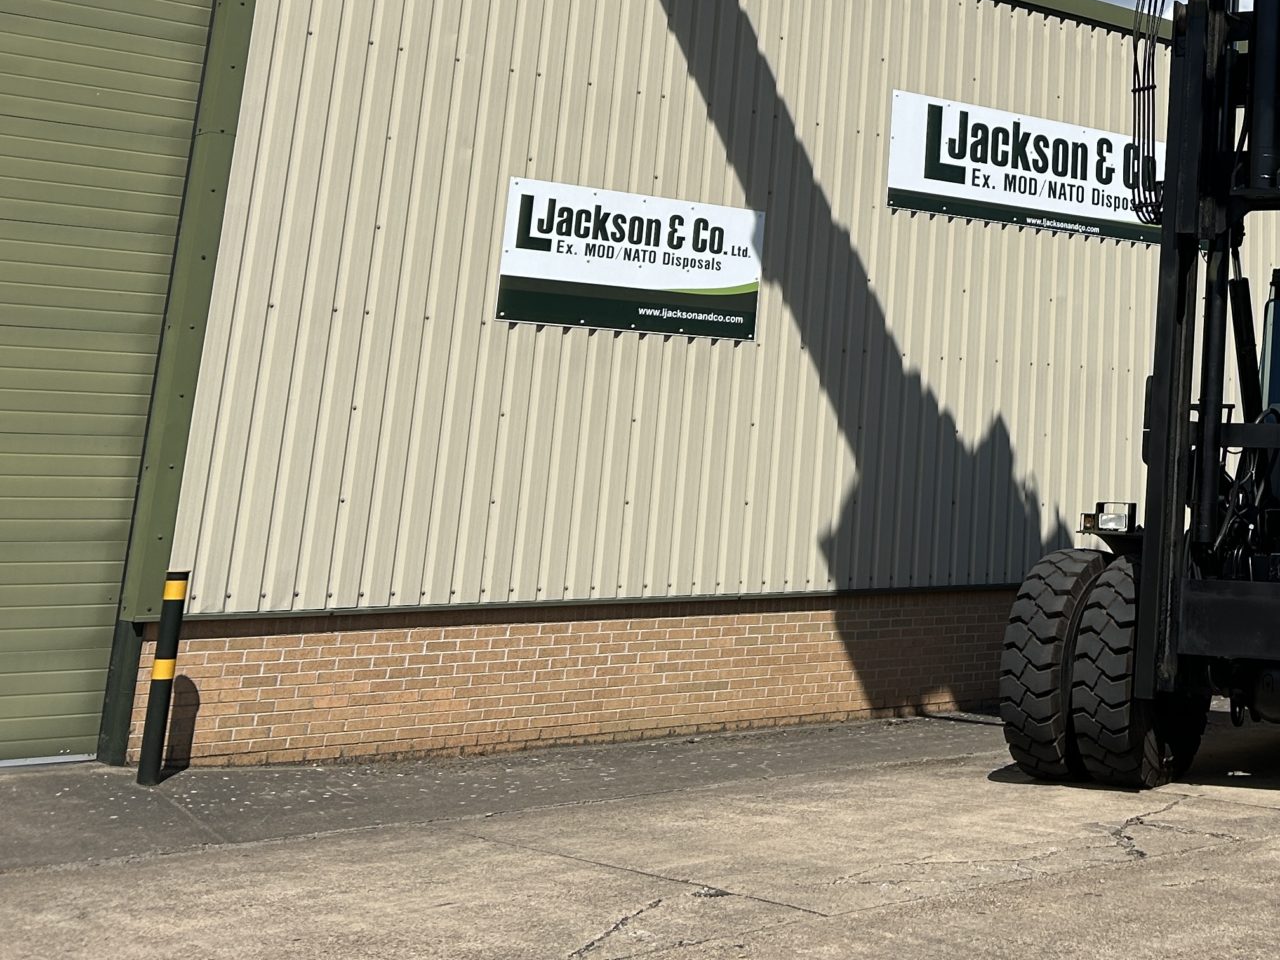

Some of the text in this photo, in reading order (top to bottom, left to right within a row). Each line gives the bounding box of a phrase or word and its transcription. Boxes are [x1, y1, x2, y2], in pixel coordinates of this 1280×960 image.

[1095, 137, 1115, 185] &
[971, 169, 1136, 212] Ex. MOD/NATO Dispos
[667, 214, 686, 250] &
[692, 217, 728, 255] Co.
[731, 245, 751, 259] Ltd.
[1026, 217, 1100, 233] www.ljacksonandco.com
[556, 240, 722, 271] Ex. MOD/NATO Disposals
[638, 307, 744, 324] www.ljacksonandco.com
